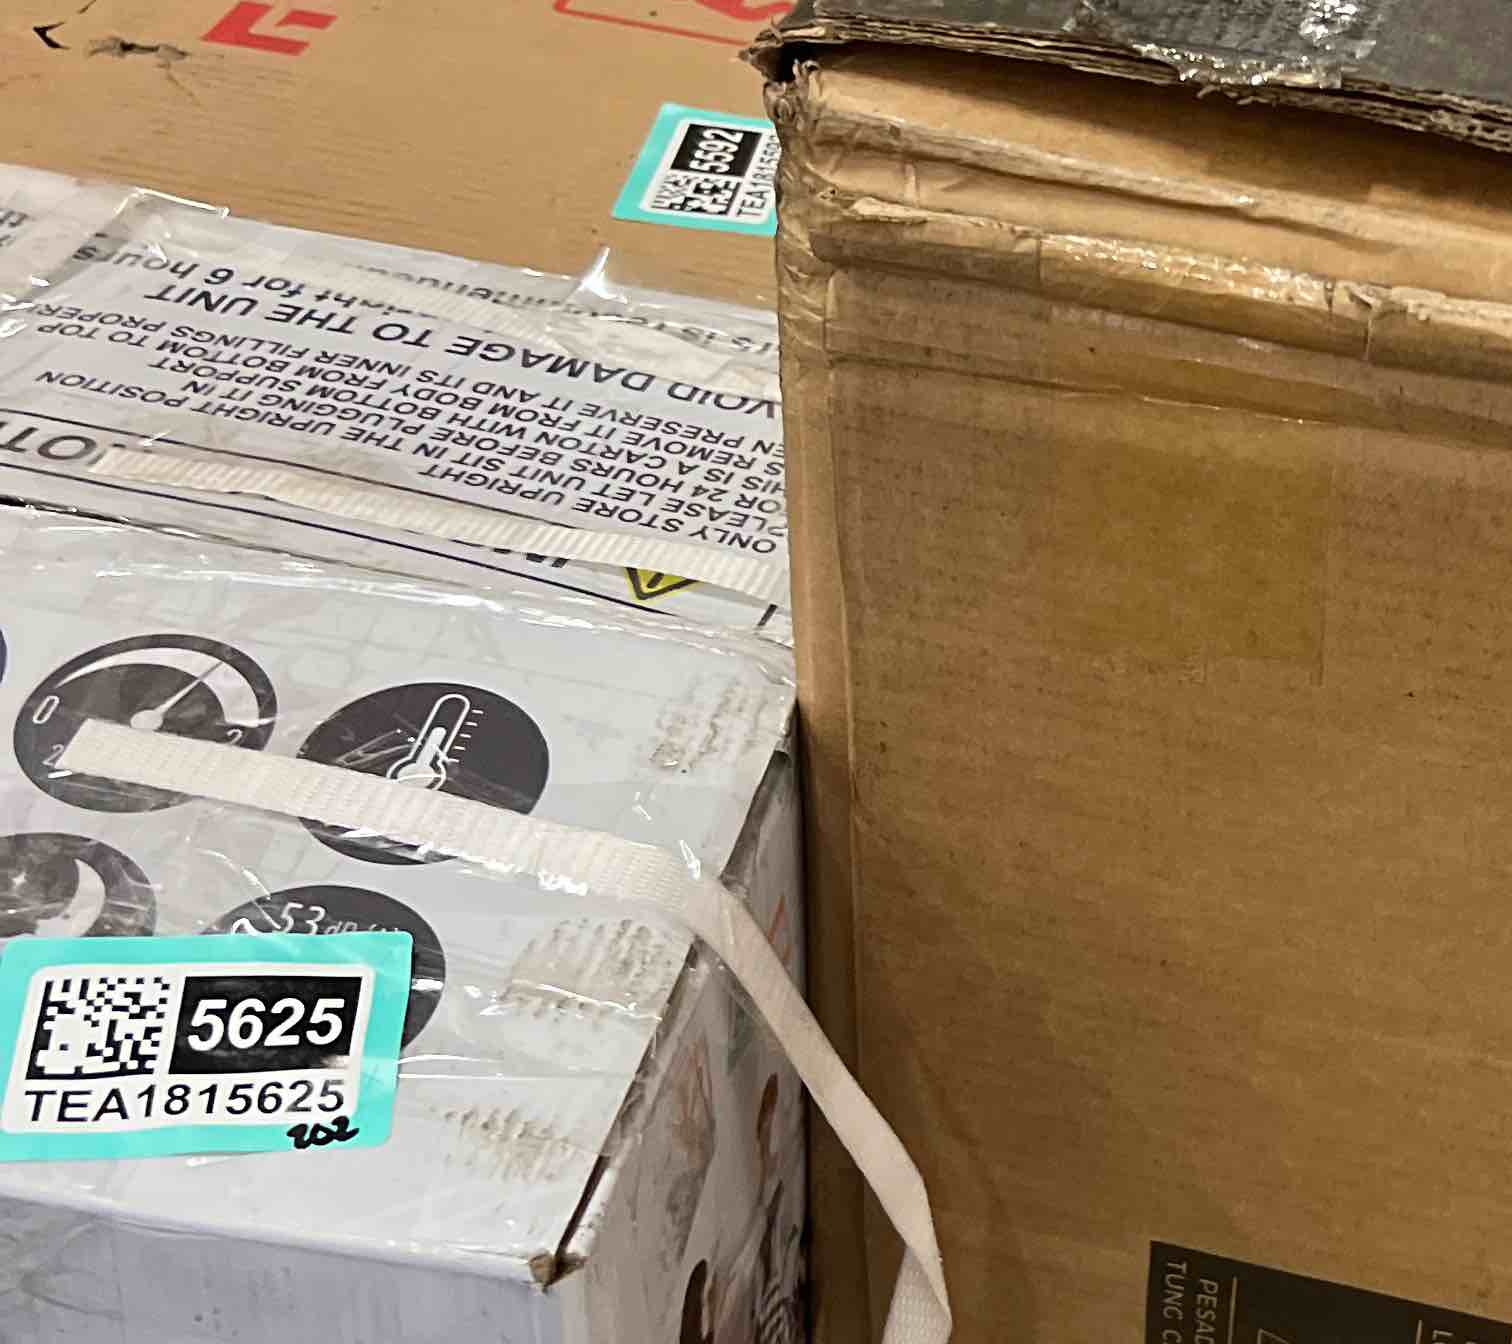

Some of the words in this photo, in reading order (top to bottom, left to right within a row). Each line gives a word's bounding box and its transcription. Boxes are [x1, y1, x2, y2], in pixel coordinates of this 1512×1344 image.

[689, 127, 745, 174] 5592
[72, 246, 200, 280] hours
[204, 268, 235, 285] 6
[143, 284, 259, 317] UNIT
[242, 275, 306, 299] for
[37, 323, 101, 340] TOP
[264, 303, 358, 335] THE
[108, 330, 150, 348] TO
[170, 325, 310, 360] FILLINGS
[372, 323, 433, 348] TO
[156, 340, 291, 373] BOTTOM
[315, 350, 413, 378] INNER
[445, 335, 656, 392] DAMAGE
[35, 369, 190, 408] POSITION
[147, 356, 302, 393] SUPPORT
[181, 380, 216, 394] IN
[296, 365, 388, 390] FROM
[416, 369, 467, 389] ITS
[219, 389, 254, 402] IT
[306, 384, 442, 421] BOTTOM
[391, 383, 484, 411] BODY
[472, 381, 541, 403] AND
[541, 396, 574, 412] IT
[667, 381, 784, 419] VOID
[190, 401, 337, 436] UPRIGHT
[257, 393, 426, 436] PLUGGING
[447, 412, 527, 440] WITH
[488, 403, 582, 432] FROM
[578, 401, 746, 449] PRESERVE
[341, 427, 404, 452] THE
[430, 426, 563, 466] BEFORE
[584, 425, 618, 439] IT
[412, 442, 449, 459] IN
[451, 452, 506, 472] SIT
[534, 431, 668, 470] CARTON
[620, 431, 757, 470] REMOVE
[508, 465, 587, 492] UNIT
[569, 458, 685, 494] HOURS
[678, 461, 700, 476] A
[703, 468, 736, 485] IS
[418, 464, 566, 506] UPRIGHT
[592, 483, 658, 506] LET
[691, 484, 729, 503] 24
[741, 475, 785, 496] HIS
[572, 497, 685, 534] STORE
[735, 493, 784, 514] OR
[689, 525, 777, 554] ONLY
[32, 695, 60, 724] 0
[186, 998, 346, 1051] 5625
[23, 1076, 347, 1125] TEA1815625
